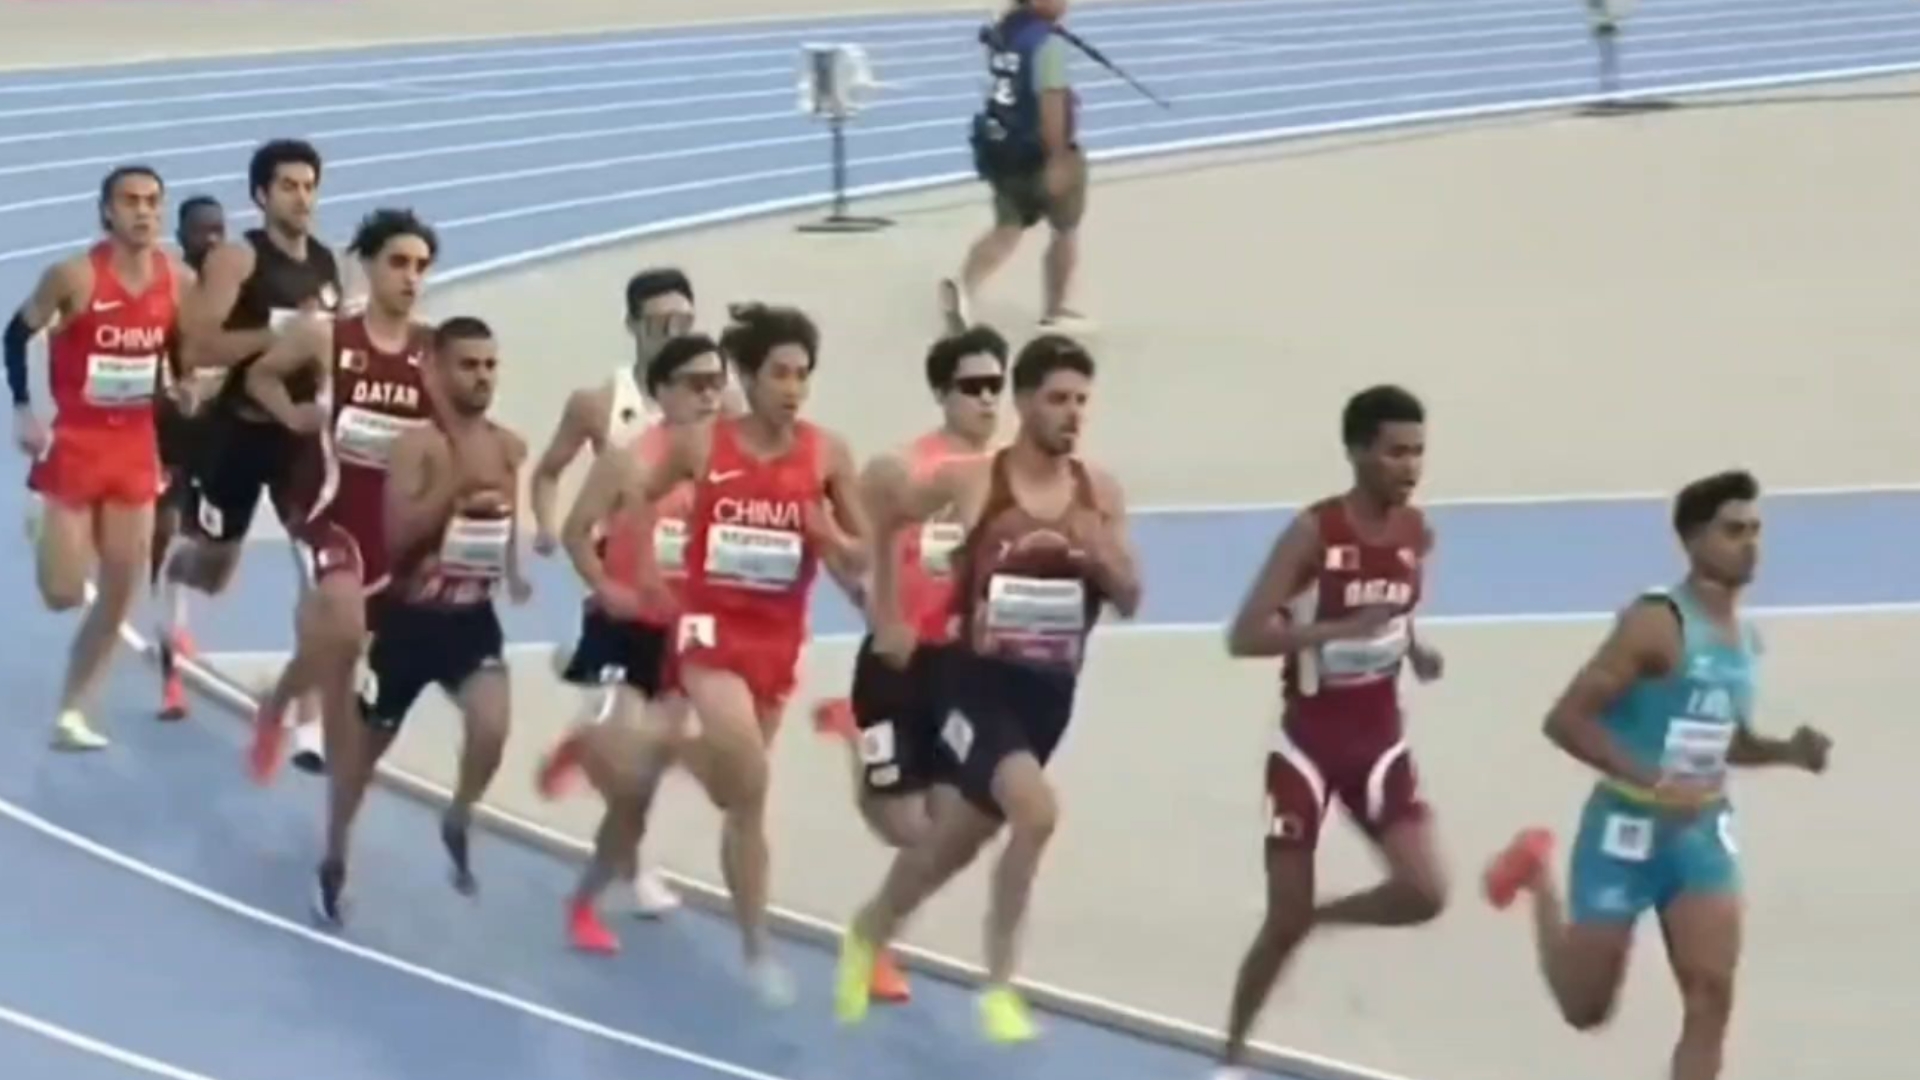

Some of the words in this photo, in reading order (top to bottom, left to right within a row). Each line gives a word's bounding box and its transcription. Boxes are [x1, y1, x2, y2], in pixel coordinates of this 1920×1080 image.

[96, 324, 164, 348] CHINA
[351, 380, 419, 409] QATAR
[714, 497, 799, 526] CHINA
